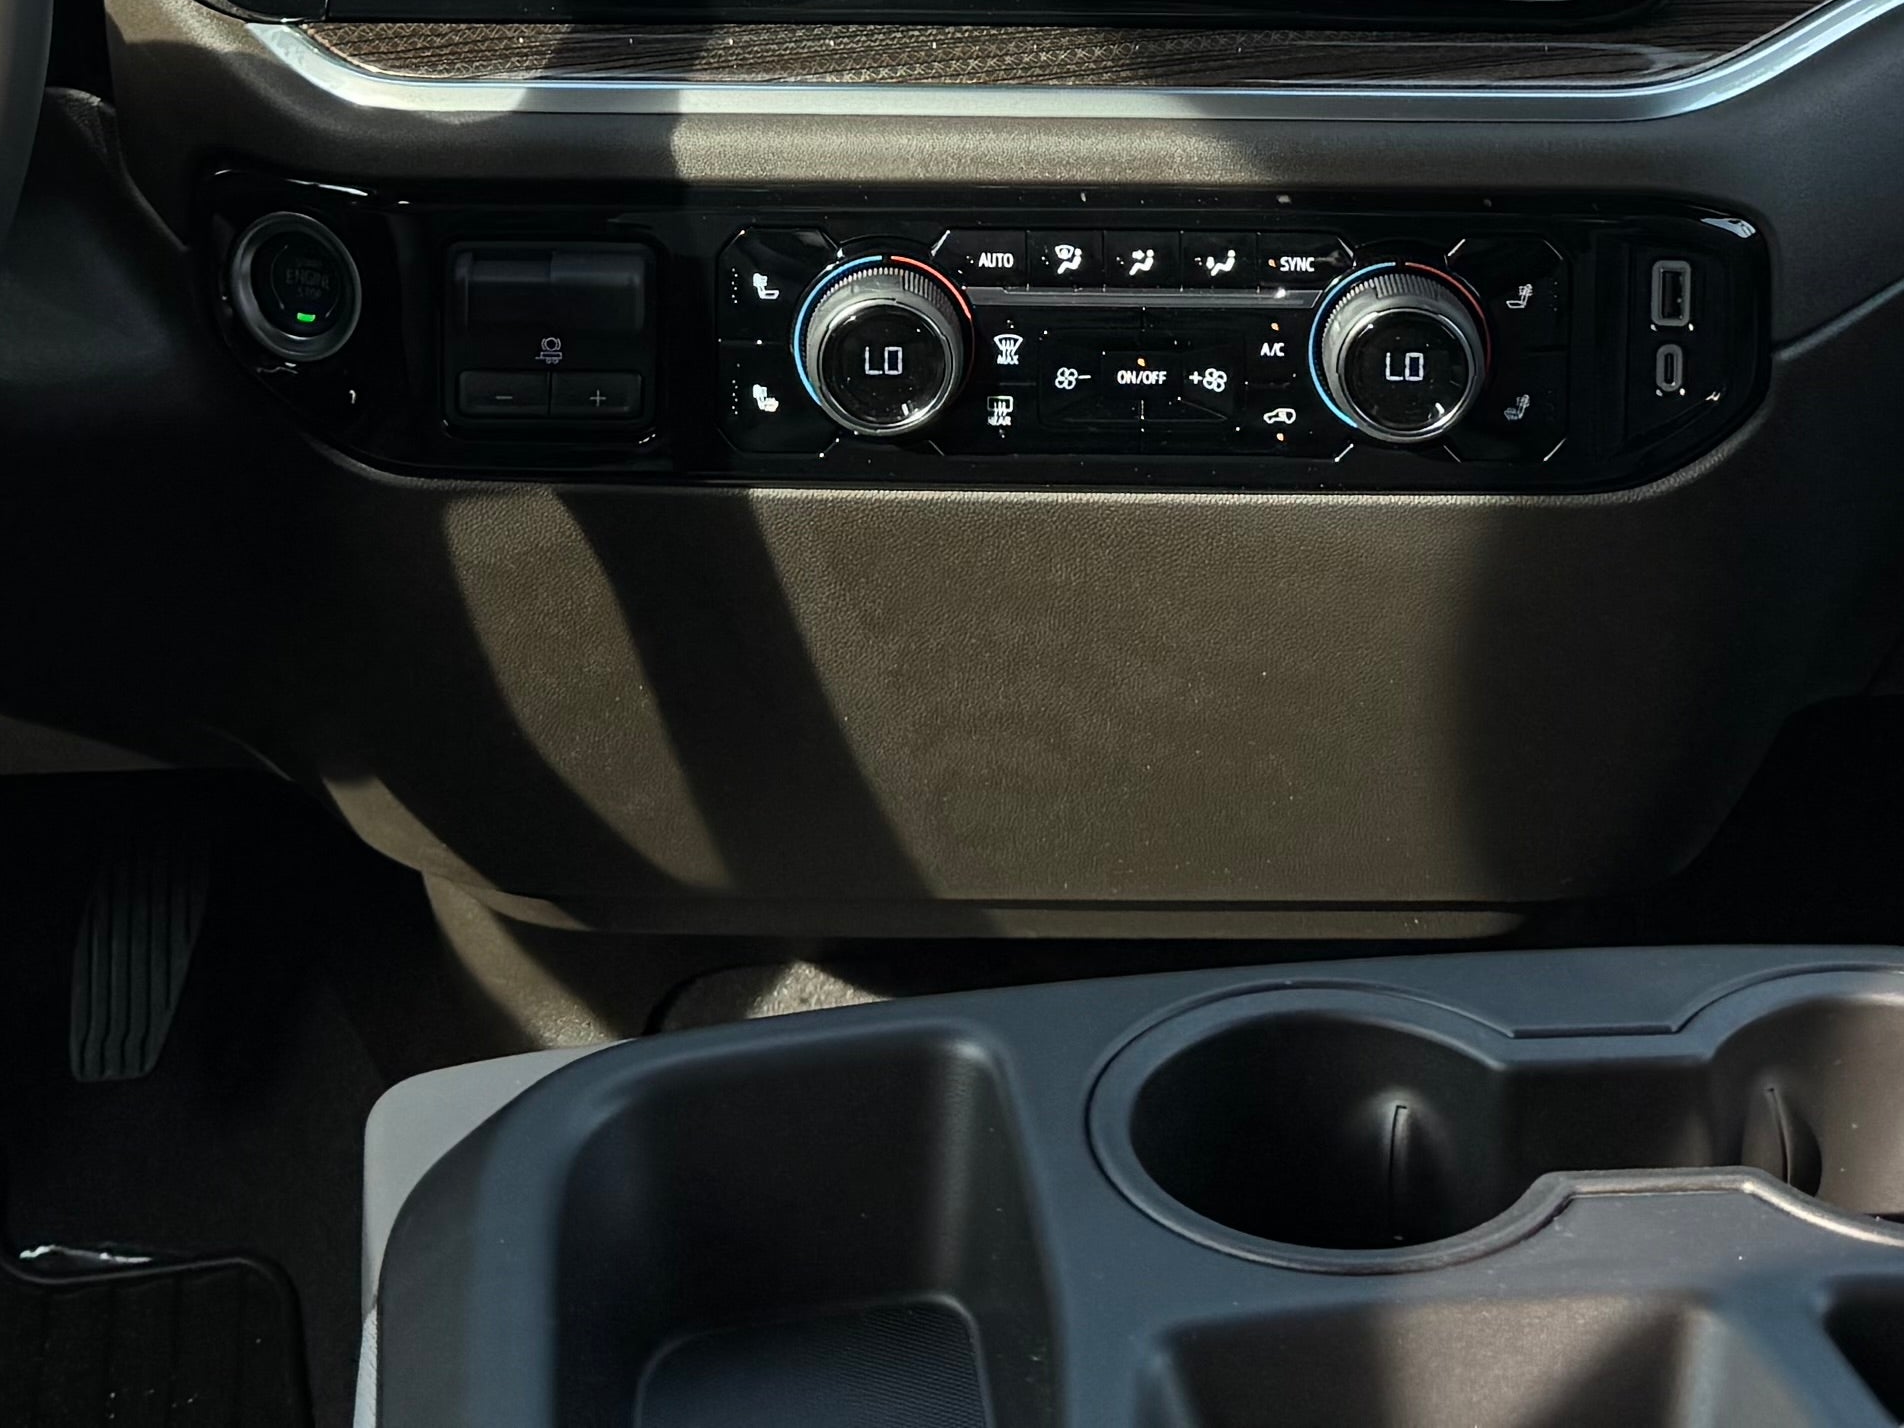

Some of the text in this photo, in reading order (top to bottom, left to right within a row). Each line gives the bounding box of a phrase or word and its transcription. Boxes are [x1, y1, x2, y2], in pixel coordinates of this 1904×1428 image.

[978, 252, 1014, 269] AUTO
[1280, 256, 1315, 272] SYNC
[1260, 342, 1285, 357] A/C
[863, 346, 903, 376] LO
[1385, 351, 1424, 382] LO
[1116, 369, 1168, 385] ON/OFF
